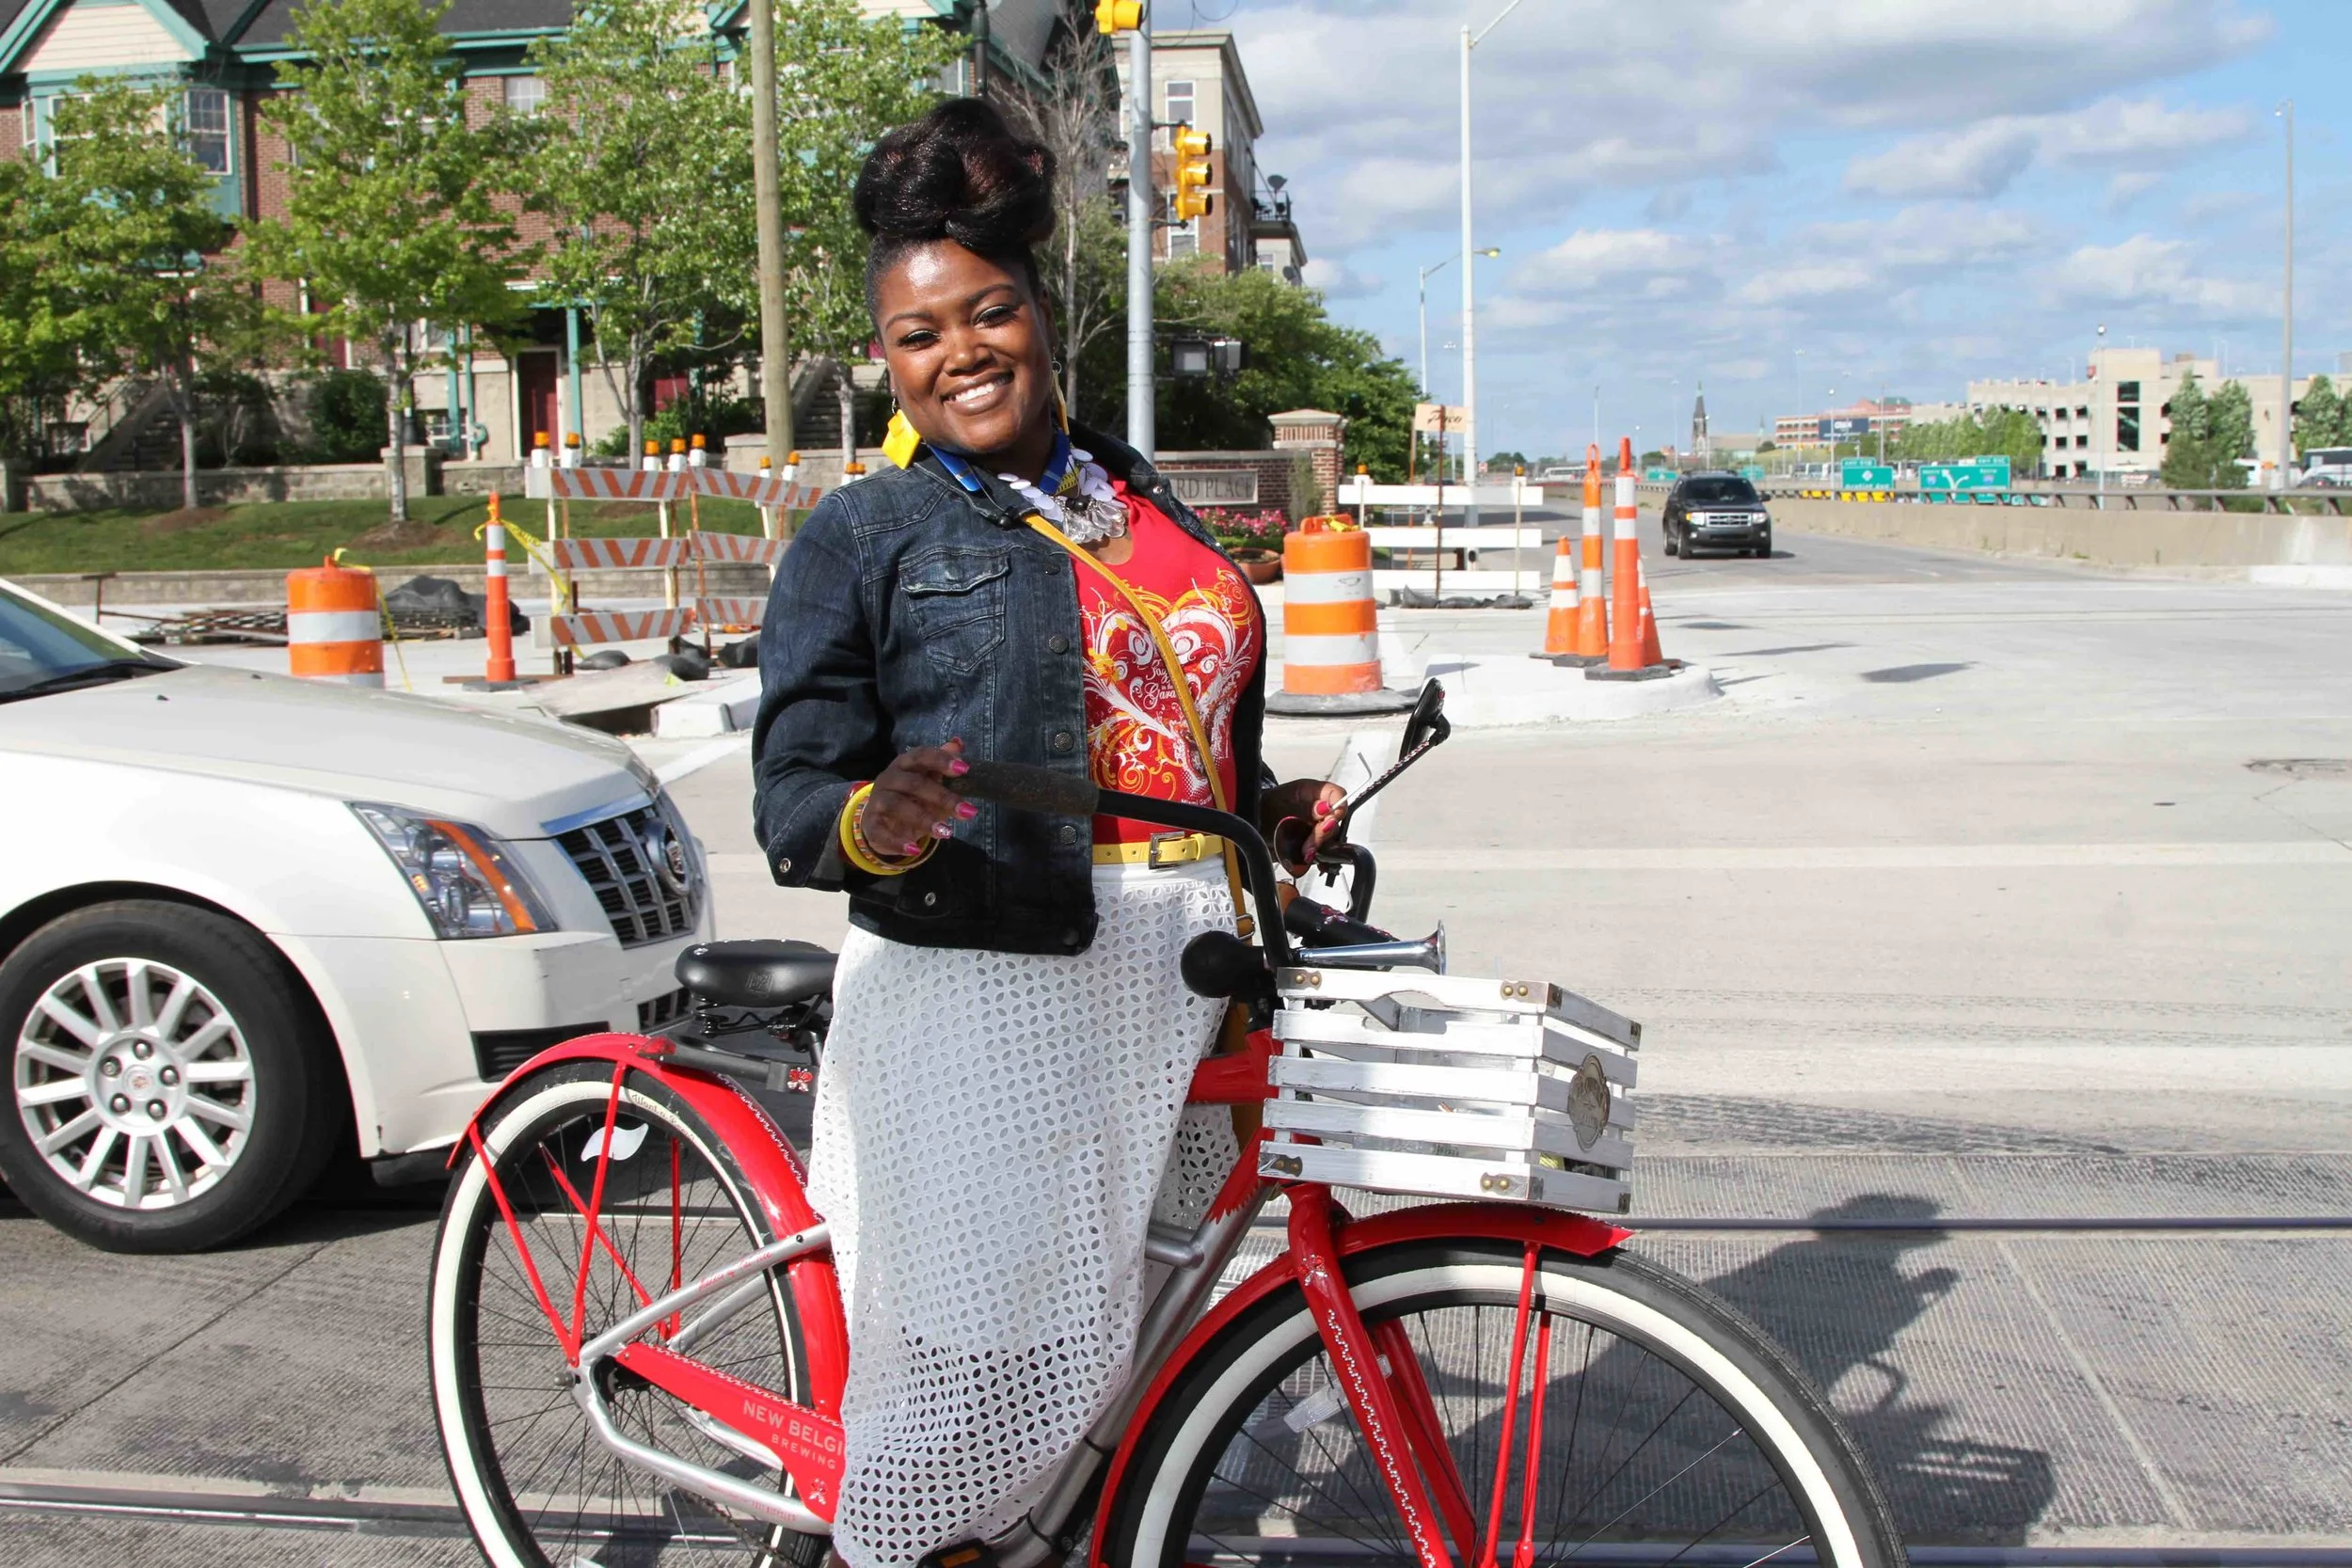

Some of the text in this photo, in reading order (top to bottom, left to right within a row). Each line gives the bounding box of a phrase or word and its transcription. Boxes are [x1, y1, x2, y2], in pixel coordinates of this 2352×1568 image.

[1205, 476, 1253, 499] PLACE
[742, 1399, 785, 1430] NEW
[771, 1433, 835, 1470] BREWING
